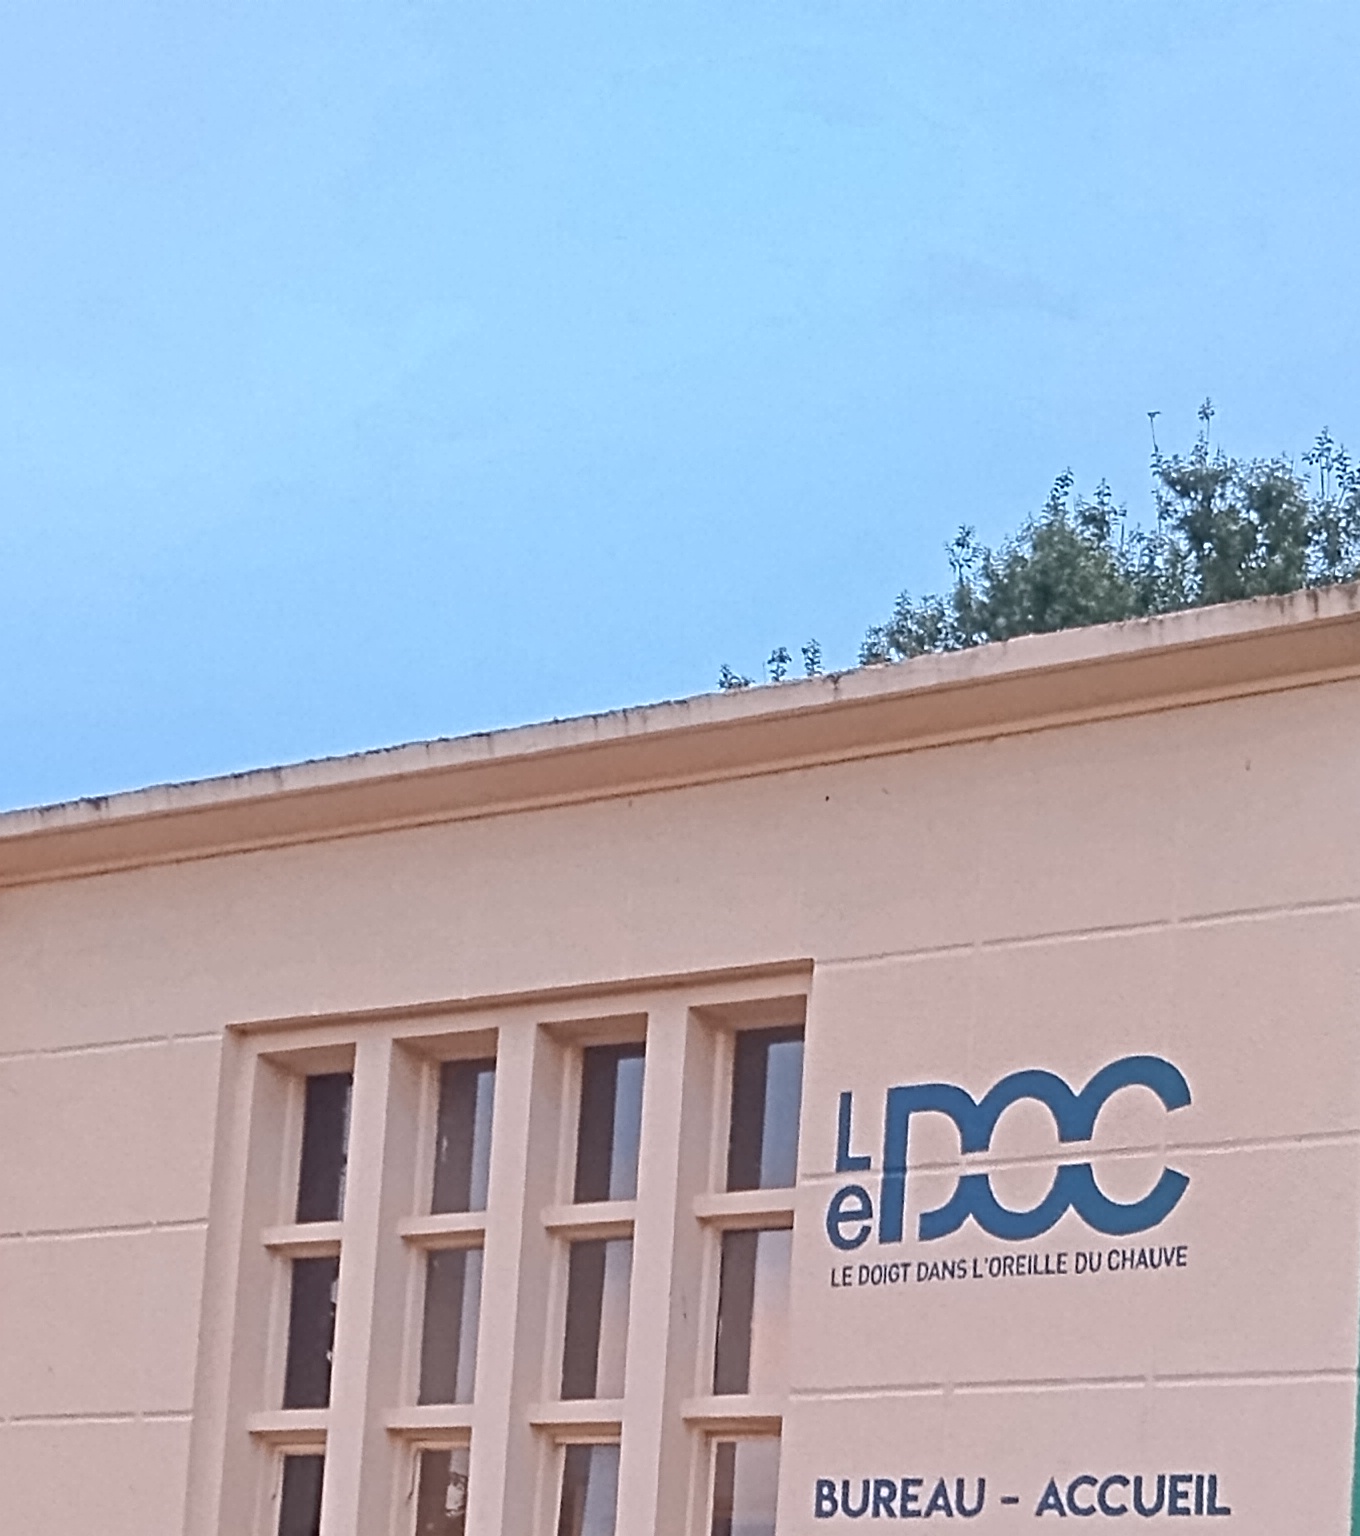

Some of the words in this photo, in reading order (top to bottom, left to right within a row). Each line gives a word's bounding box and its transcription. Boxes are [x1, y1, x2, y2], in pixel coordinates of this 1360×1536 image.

[878, 1055, 1192, 1245] DOC
[830, 1265, 853, 1288] LE
[858, 1262, 912, 1286] DOIGT
[916, 1259, 968, 1283] DANS
[972, 1252, 1068, 1279] L'OREILLE
[1074, 1251, 1102, 1275] DU
[1107, 1245, 1188, 1271] CHAUVE
[813, 1477, 986, 1519] BUREAU
[1034, 1473, 1232, 1518] ACCUEIL
